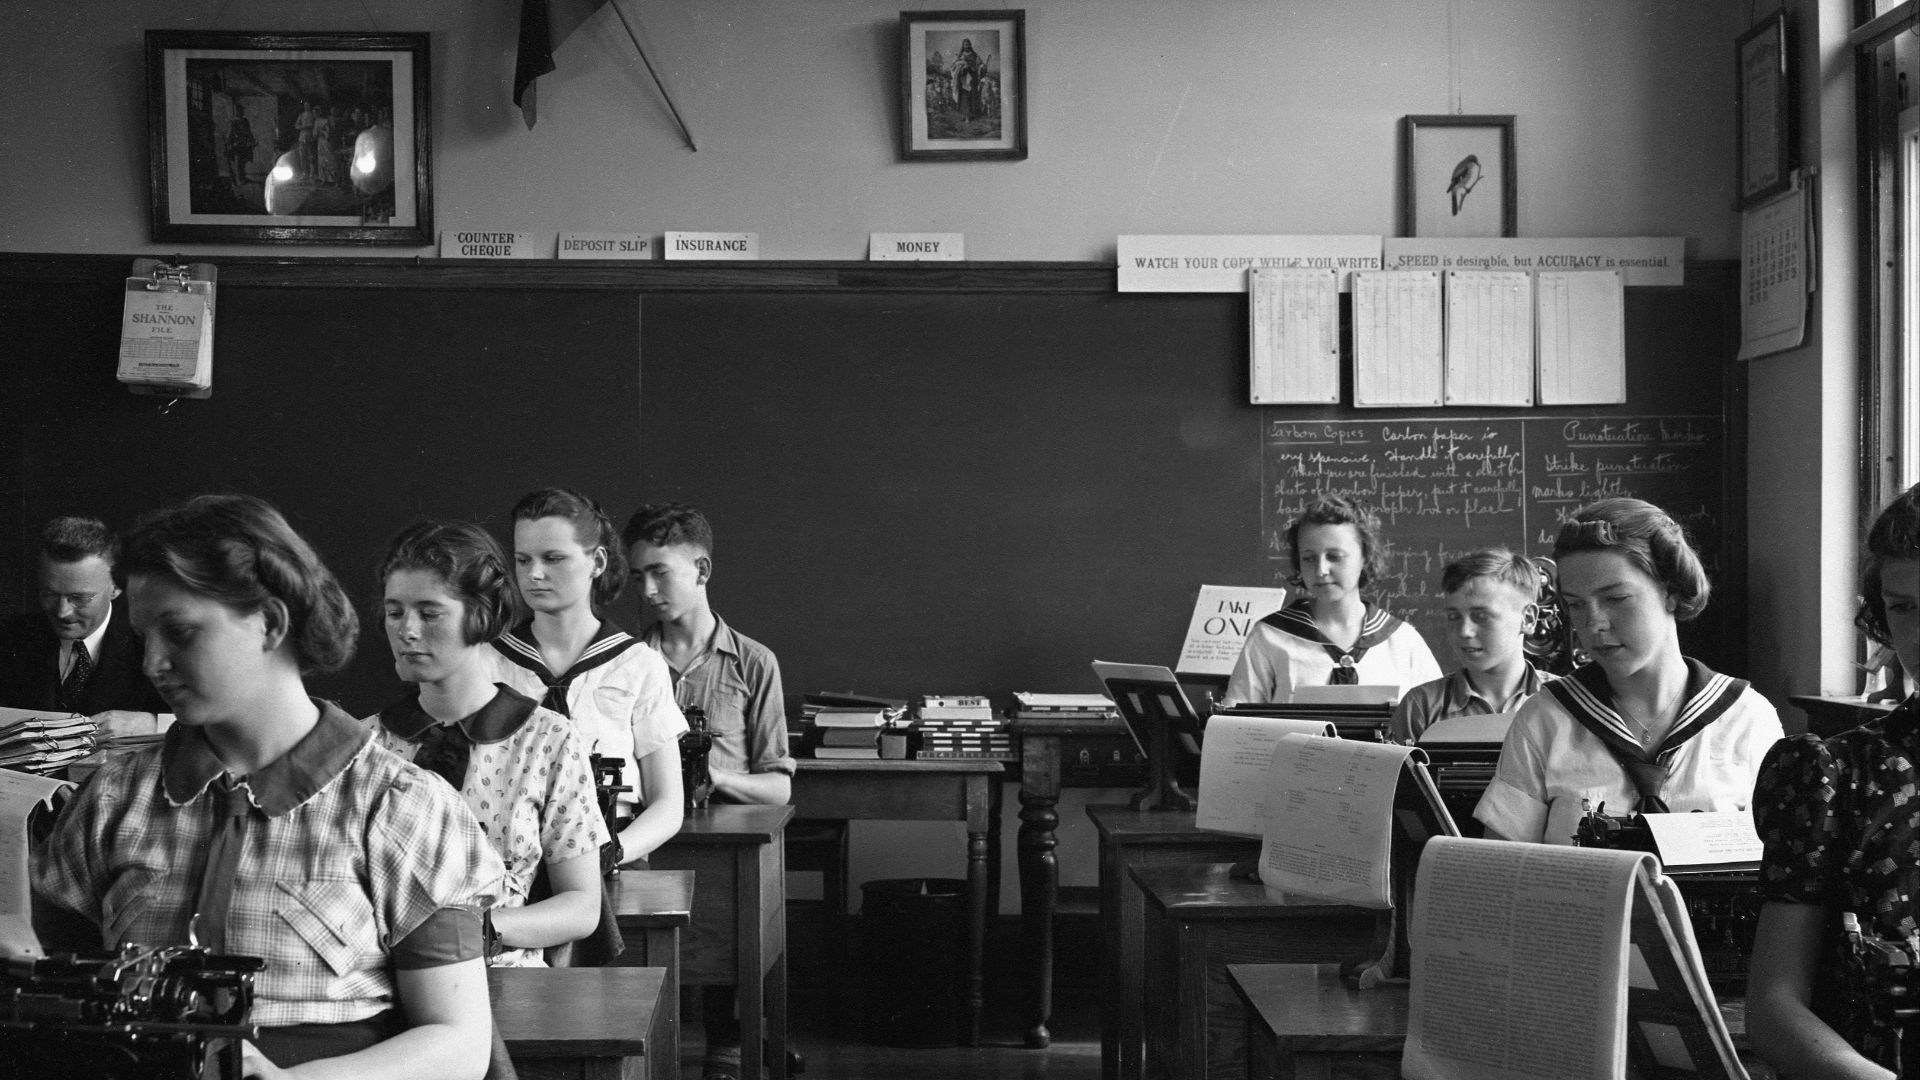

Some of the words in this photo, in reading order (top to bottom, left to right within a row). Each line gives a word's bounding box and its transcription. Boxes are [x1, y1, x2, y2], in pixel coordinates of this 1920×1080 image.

[457, 232, 515, 244] COUNTER
[462, 245, 512, 257] CHEQUE
[563, 240, 614, 252] DEPOSIT
[619, 241, 648, 252] SLIP
[675, 240, 748, 252] INSURANCE
[896, 241, 940, 253] MONEY
[1135, 257, 1179, 269] WATCH
[1184, 257, 1218, 269] YOUR
[1222, 257, 1254, 269] COPY
[1260, 257, 1302, 268] WHILE
[1307, 257, 1333, 268] YOU
[1337, 257, 1378, 269] WRITE
[1398, 255, 1439, 268] SPEED
[1443, 255, 1451, 267] is
[1456, 255, 1510, 269] desirable,
[1514, 255, 1532, 267] but
[1537, 256, 1601, 268] ACCURACY
[1606, 256, 1616, 267] is
[1619, 256, 1670, 268] essential.
[156, 304, 174, 312] THE
[132, 313, 196, 326] SHANNON
[1269, 424, 1318, 438] Carbon
[1323, 425, 1365, 446] Copies
[1382, 426, 1427, 442] Carbon
[1432, 427, 1474, 454] paper
[1545, 451, 1590, 472] Strike
[1203, 616, 1253, 637] ONE
